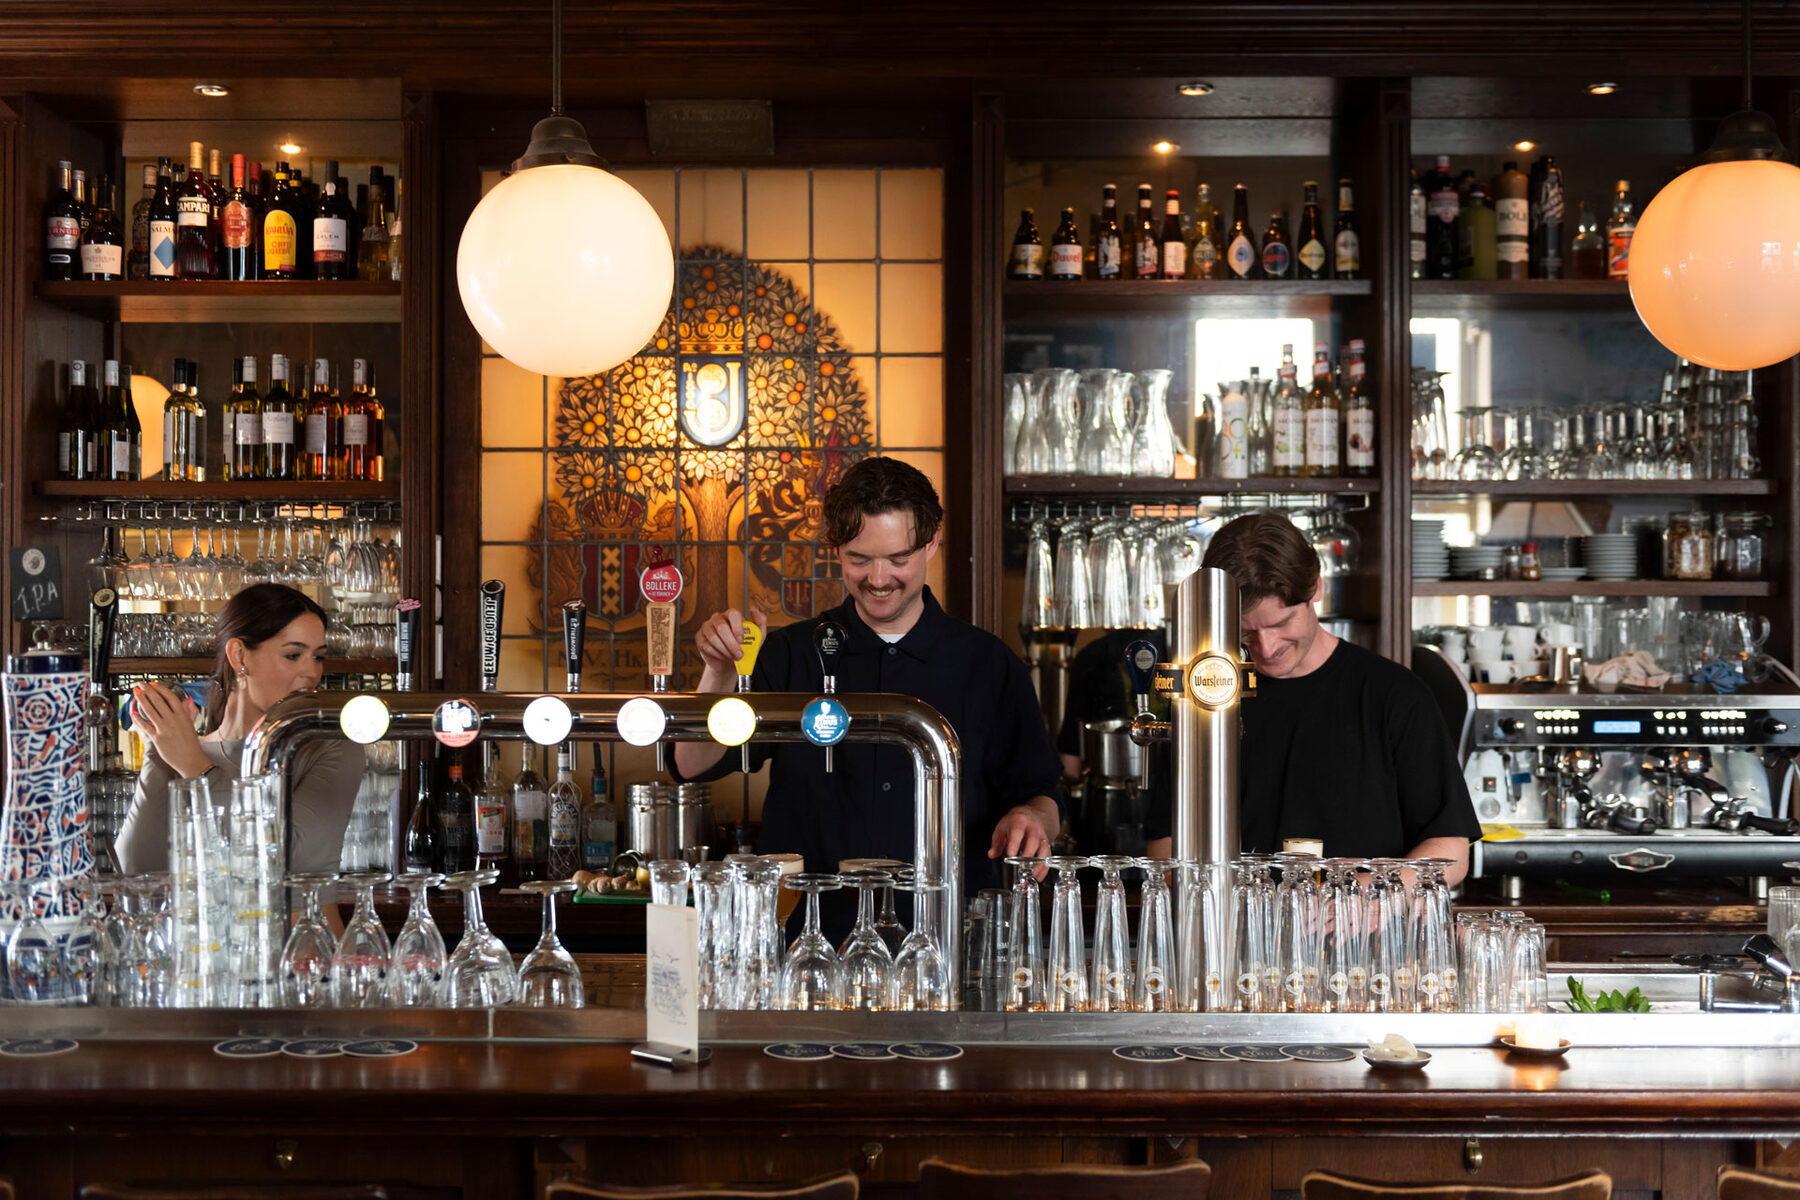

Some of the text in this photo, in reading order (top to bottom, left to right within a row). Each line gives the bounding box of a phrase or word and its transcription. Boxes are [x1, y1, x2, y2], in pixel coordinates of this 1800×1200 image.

[177, 201, 210, 214] CAMPARI
[1052, 250, 1082, 263] Duvel
[645, 581, 677, 591] BOLLEKE
[482, 630, 497, 674] EEUWIGE
[1194, 674, 1234, 688] Warsteiner
